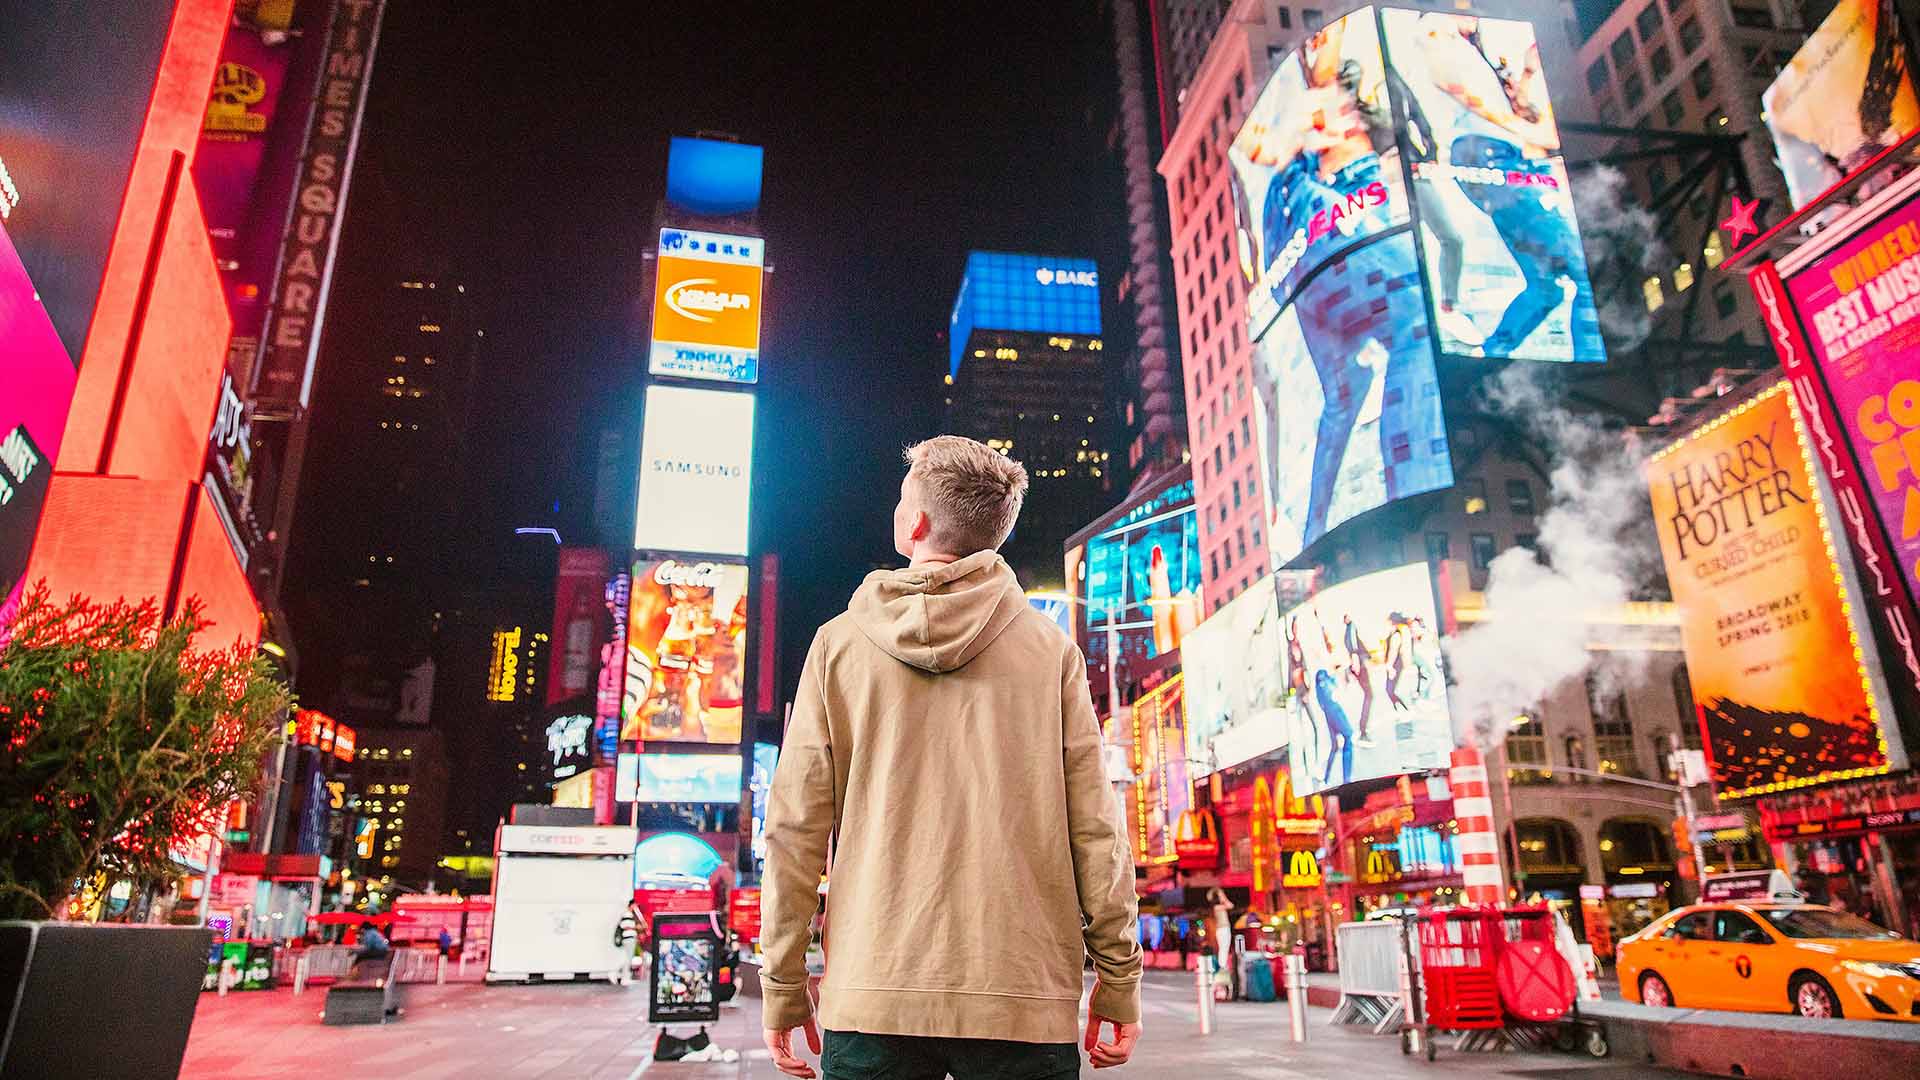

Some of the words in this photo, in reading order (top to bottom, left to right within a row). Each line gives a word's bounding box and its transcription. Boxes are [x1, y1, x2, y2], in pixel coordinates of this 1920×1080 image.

[1307, 181, 1387, 246] JEANS
[275, 153, 337, 347] SQUARE
[1812, 288, 1869, 345] BEST
[653, 459, 741, 478] SAMSUNG
[1669, 420, 1779, 513] HARRY
[1672, 469, 1808, 560] POTTER
[1866, 812, 1904, 827] SONY
